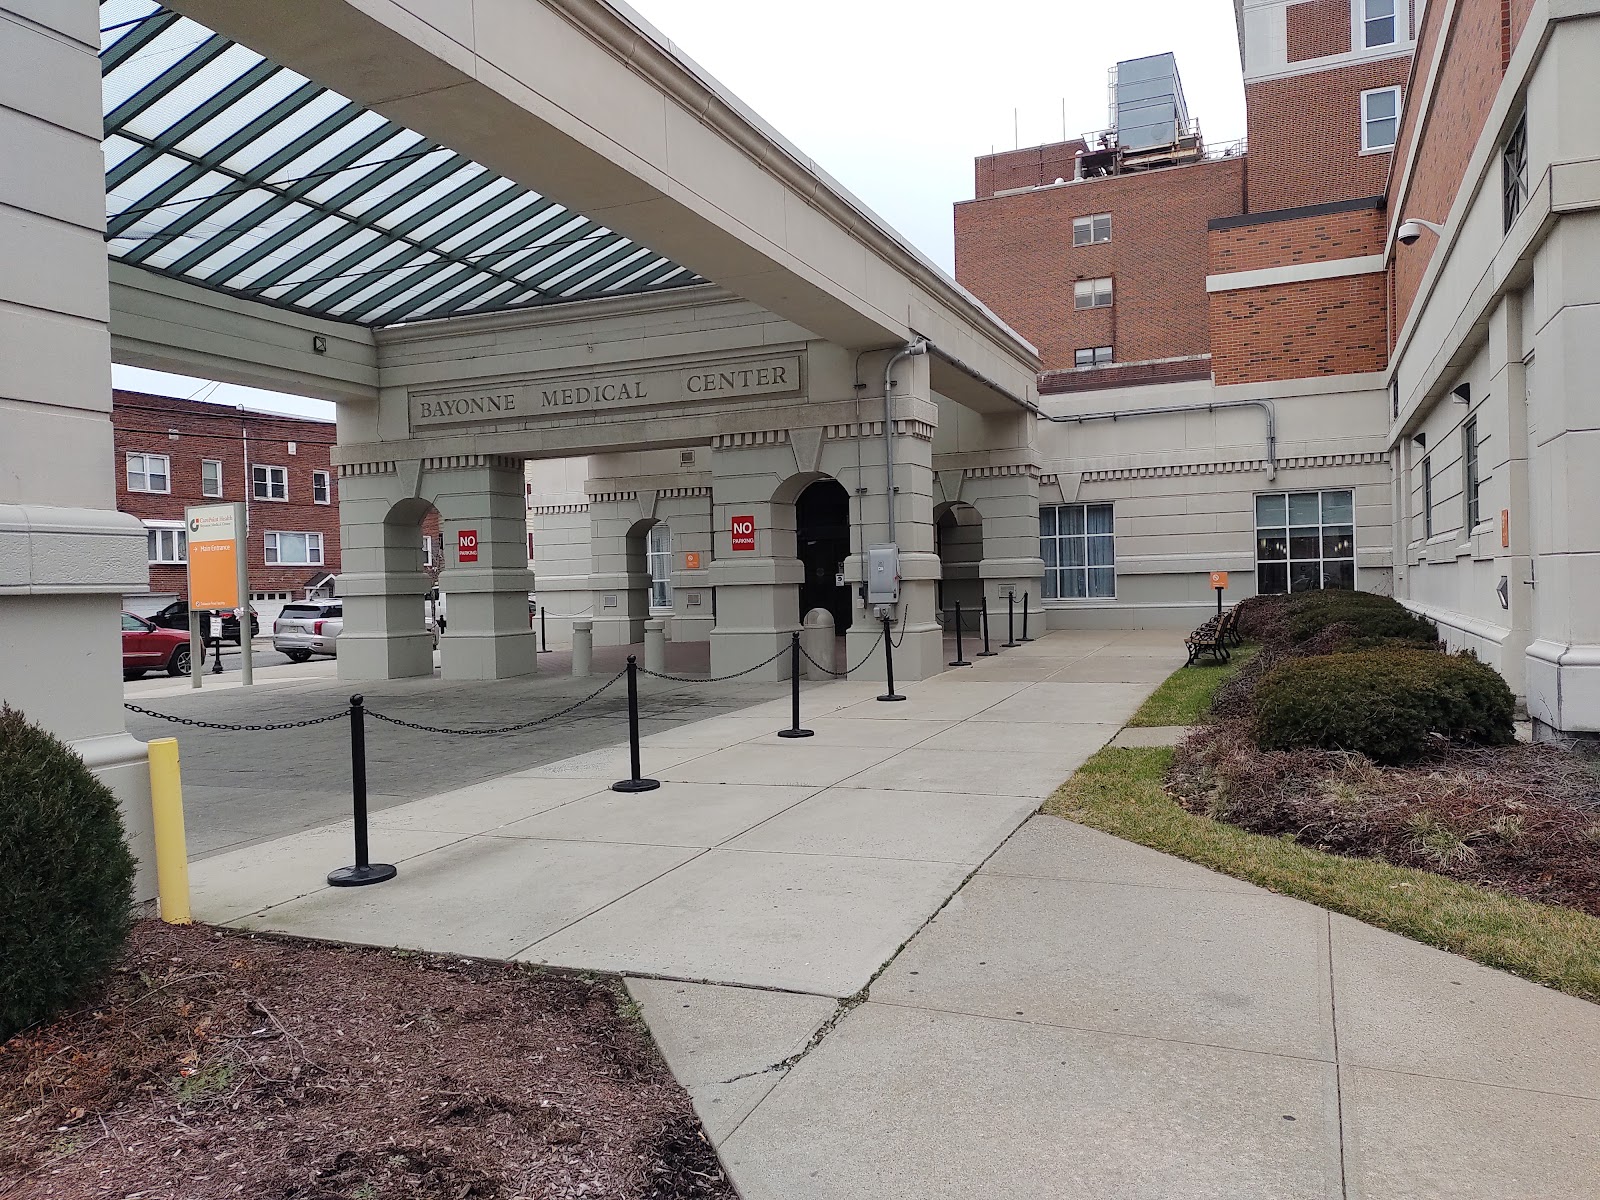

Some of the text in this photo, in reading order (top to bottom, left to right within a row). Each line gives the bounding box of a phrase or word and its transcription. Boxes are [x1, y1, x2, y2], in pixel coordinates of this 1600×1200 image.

[420, 366, 788, 419] BAYONNE MEDICAL CENTER
[733, 522, 752, 534] NO
[459, 536, 476, 547] NO
